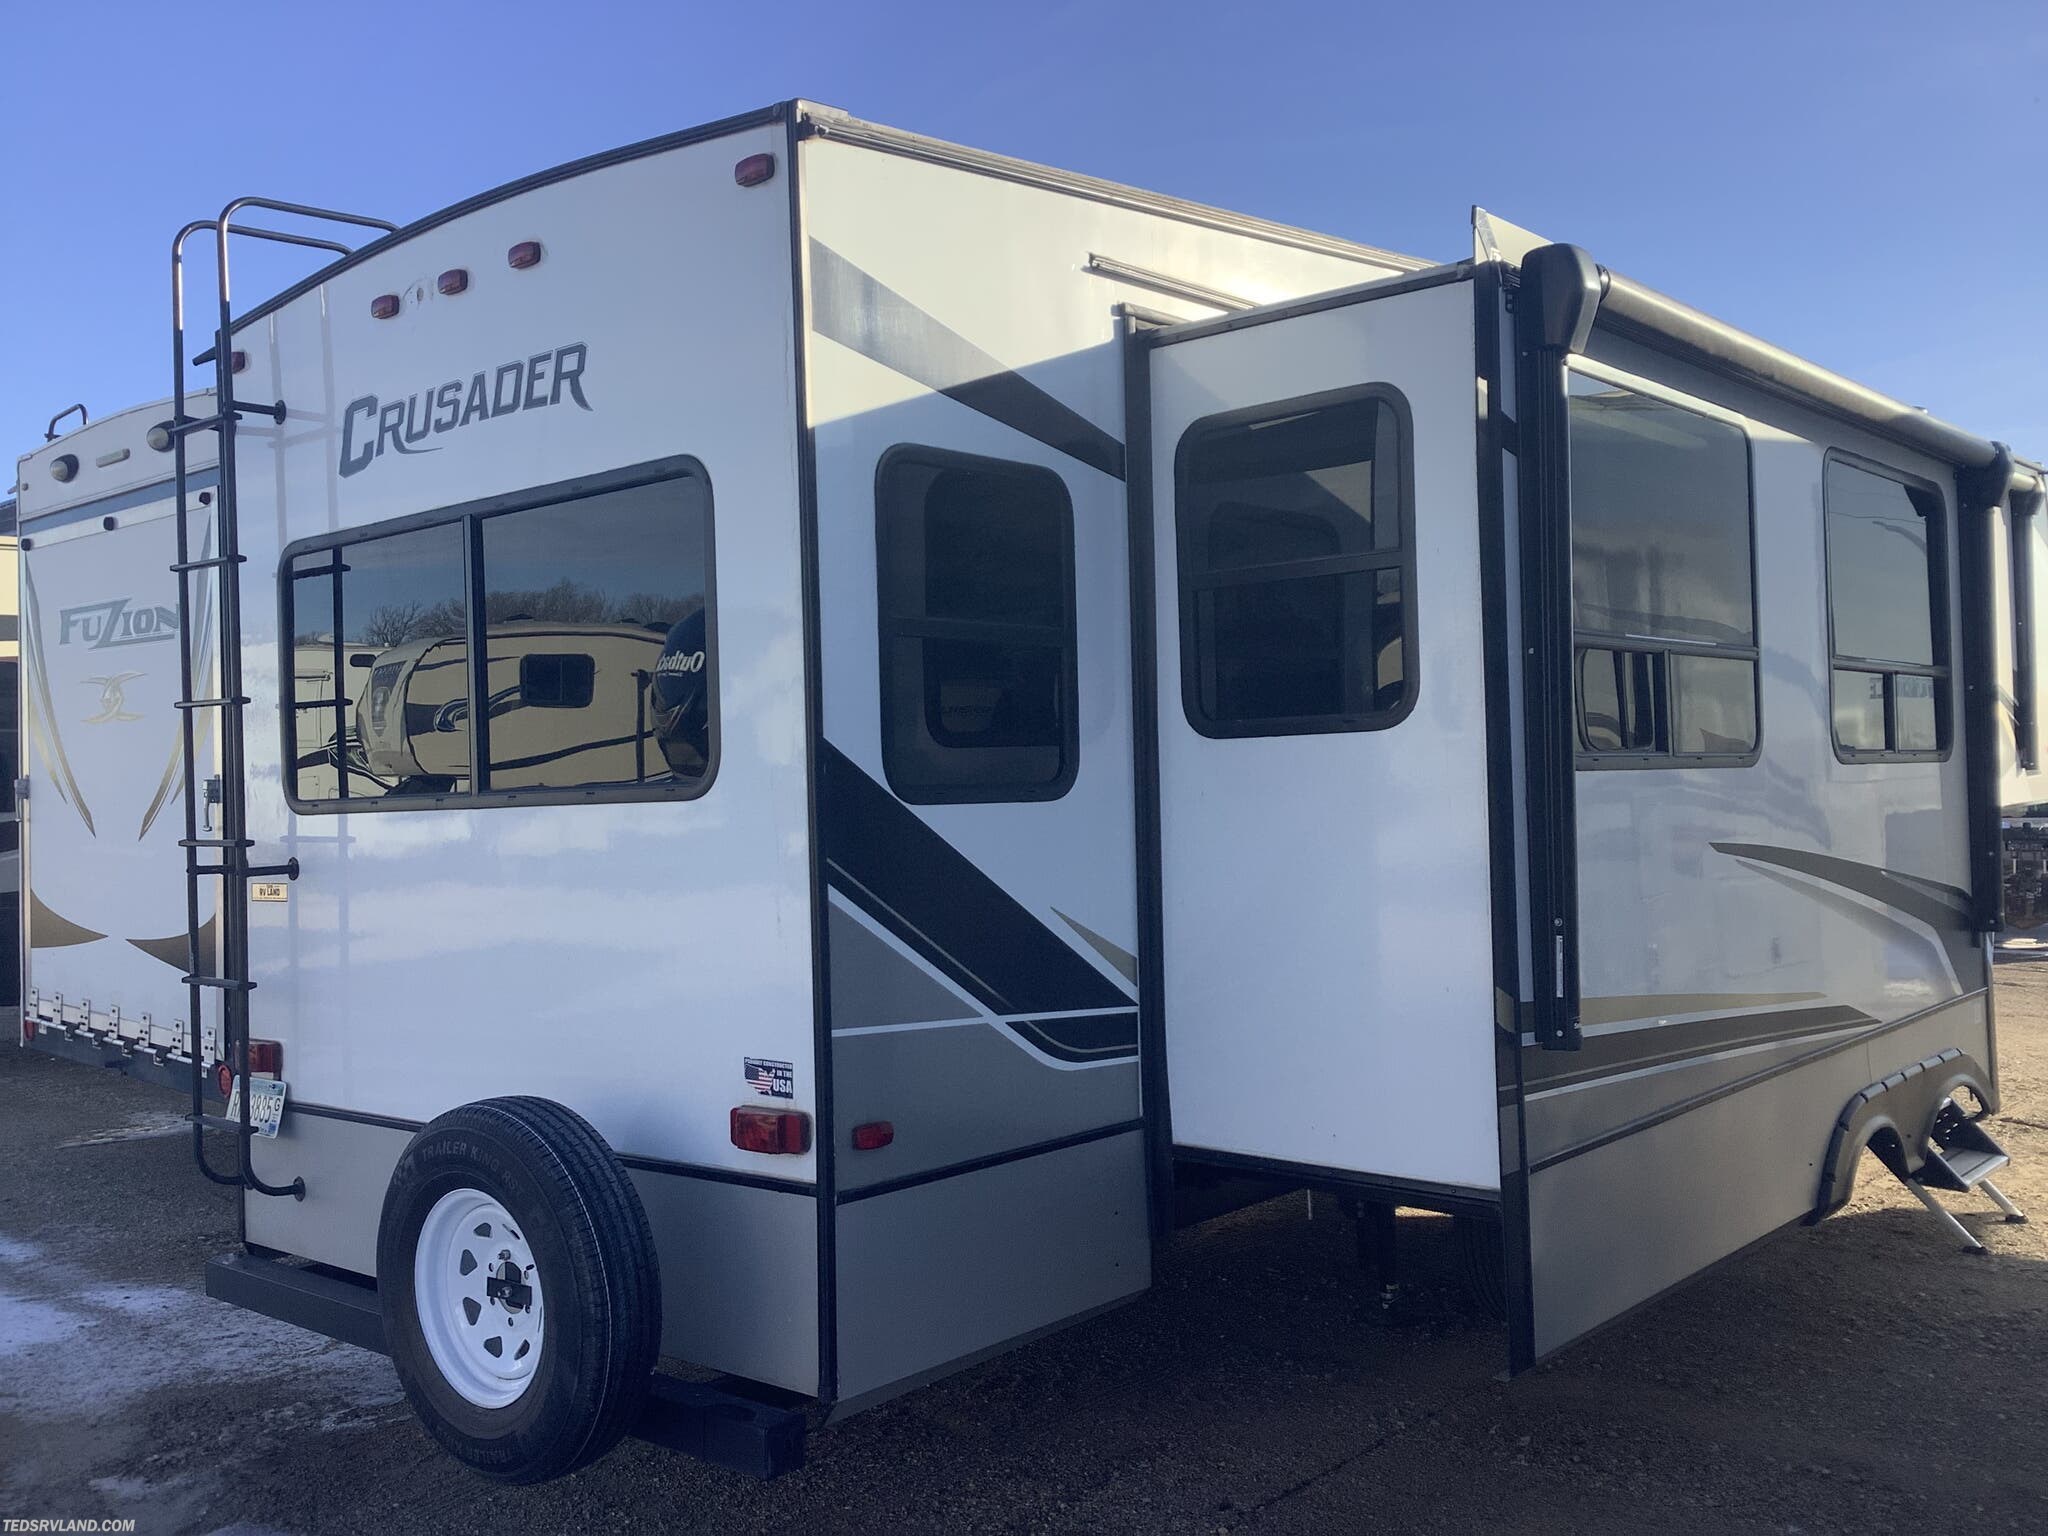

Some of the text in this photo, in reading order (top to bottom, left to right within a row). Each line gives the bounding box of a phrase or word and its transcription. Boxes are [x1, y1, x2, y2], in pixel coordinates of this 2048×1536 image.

[338, 341, 594, 479] CRUSADER
[59, 599, 180, 652] FUZION
[773, 1078, 792, 1093] USA
[784, 1070, 792, 1078] THE
[422, 1139, 467, 1162] TRAILER
